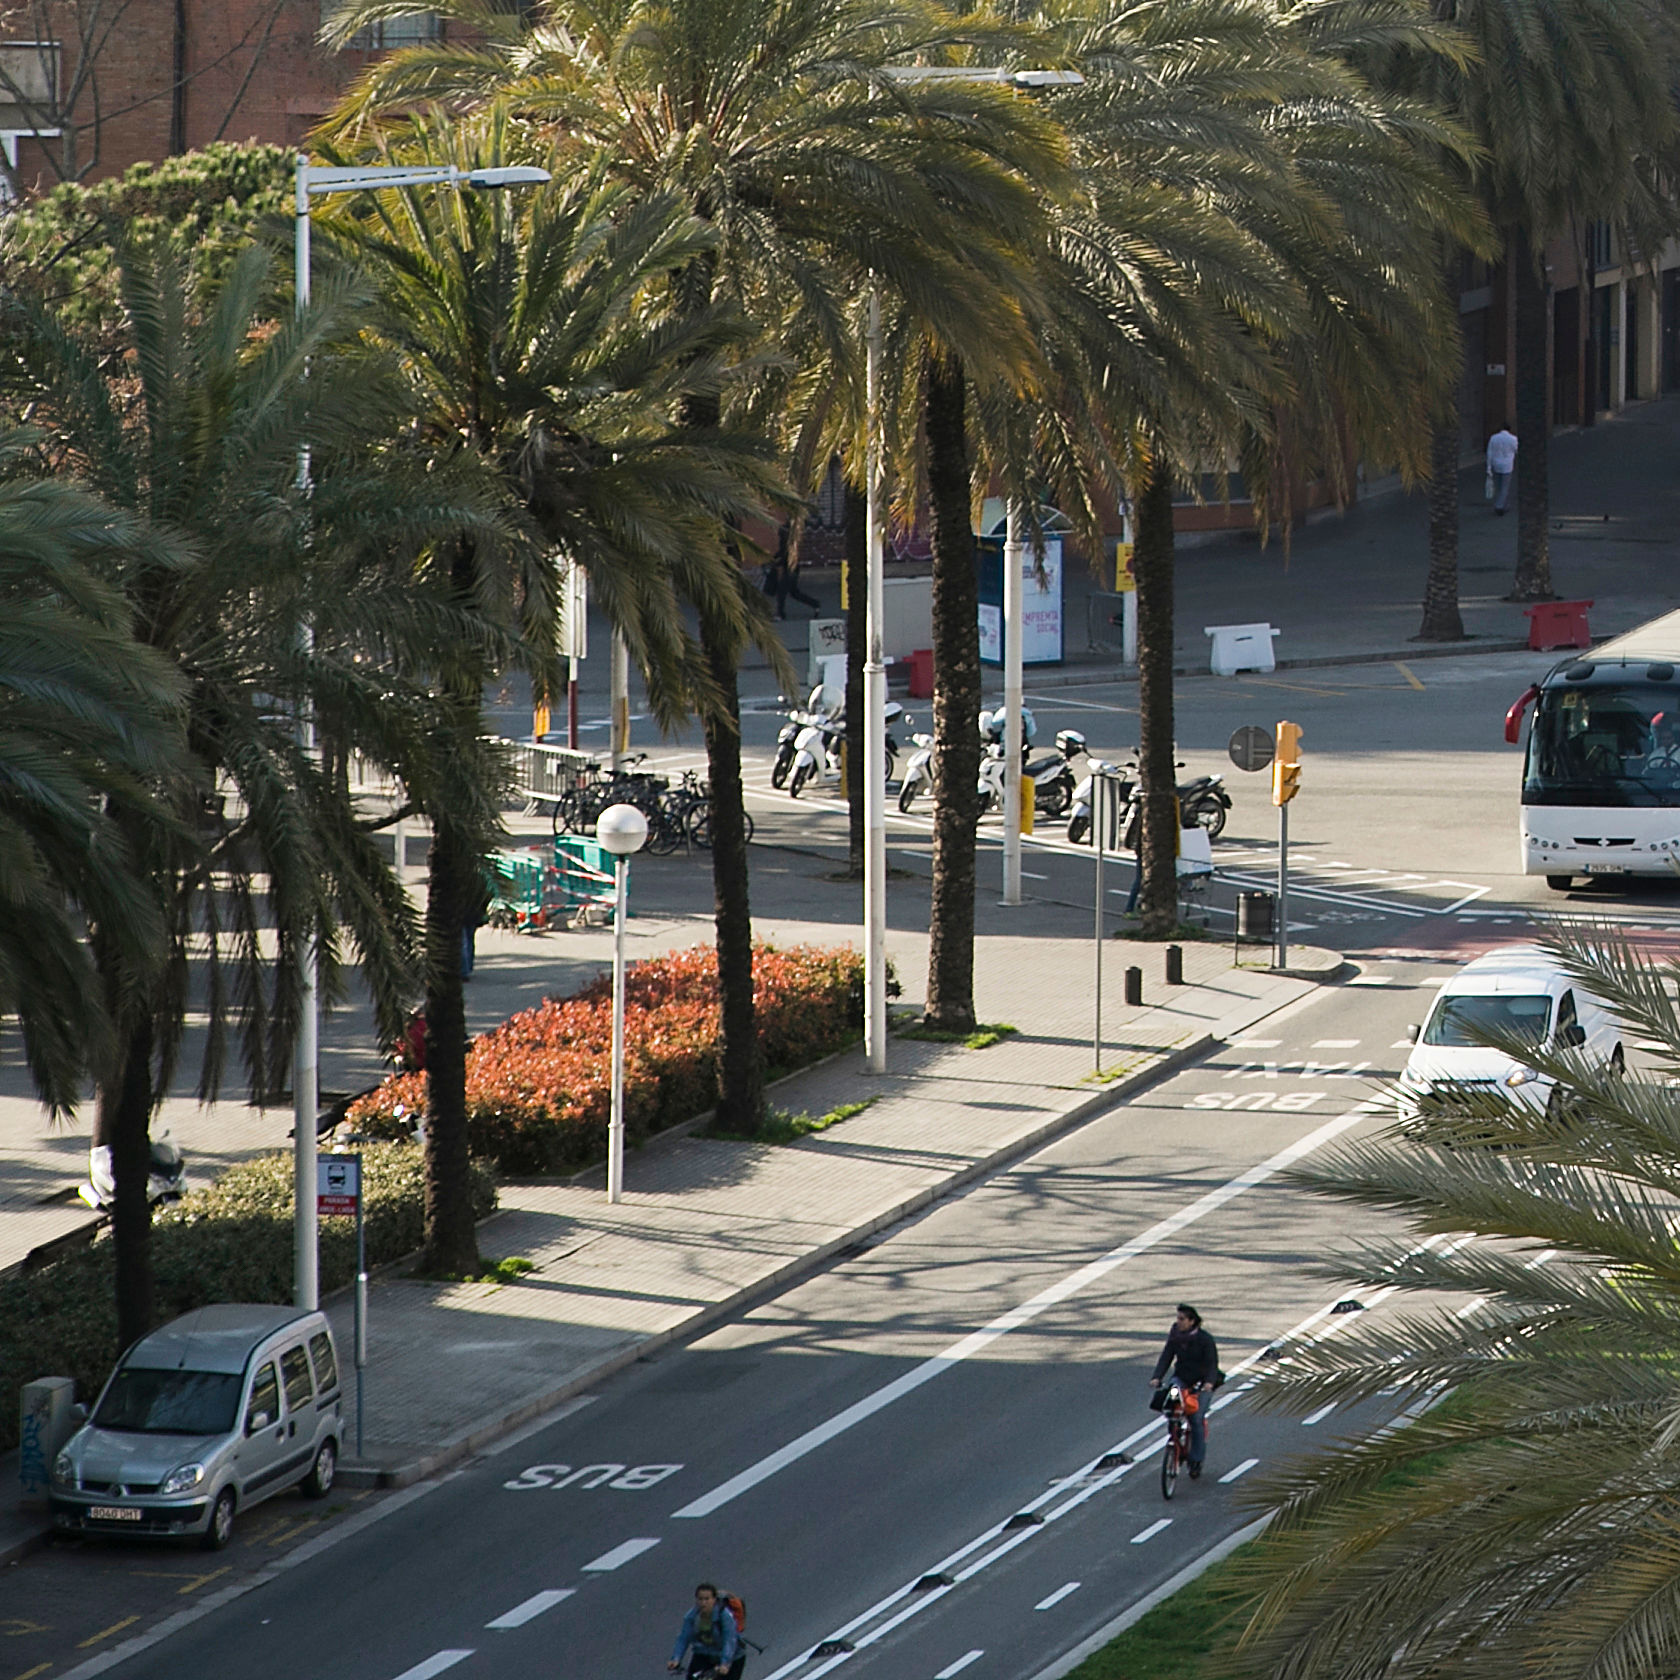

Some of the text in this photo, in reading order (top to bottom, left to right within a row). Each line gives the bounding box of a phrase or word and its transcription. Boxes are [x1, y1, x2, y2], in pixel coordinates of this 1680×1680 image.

[1221, 1061, 1373, 1079] TAXI
[1182, 1091, 1328, 1111] BUS
[502, 1463, 686, 1490] BUS
